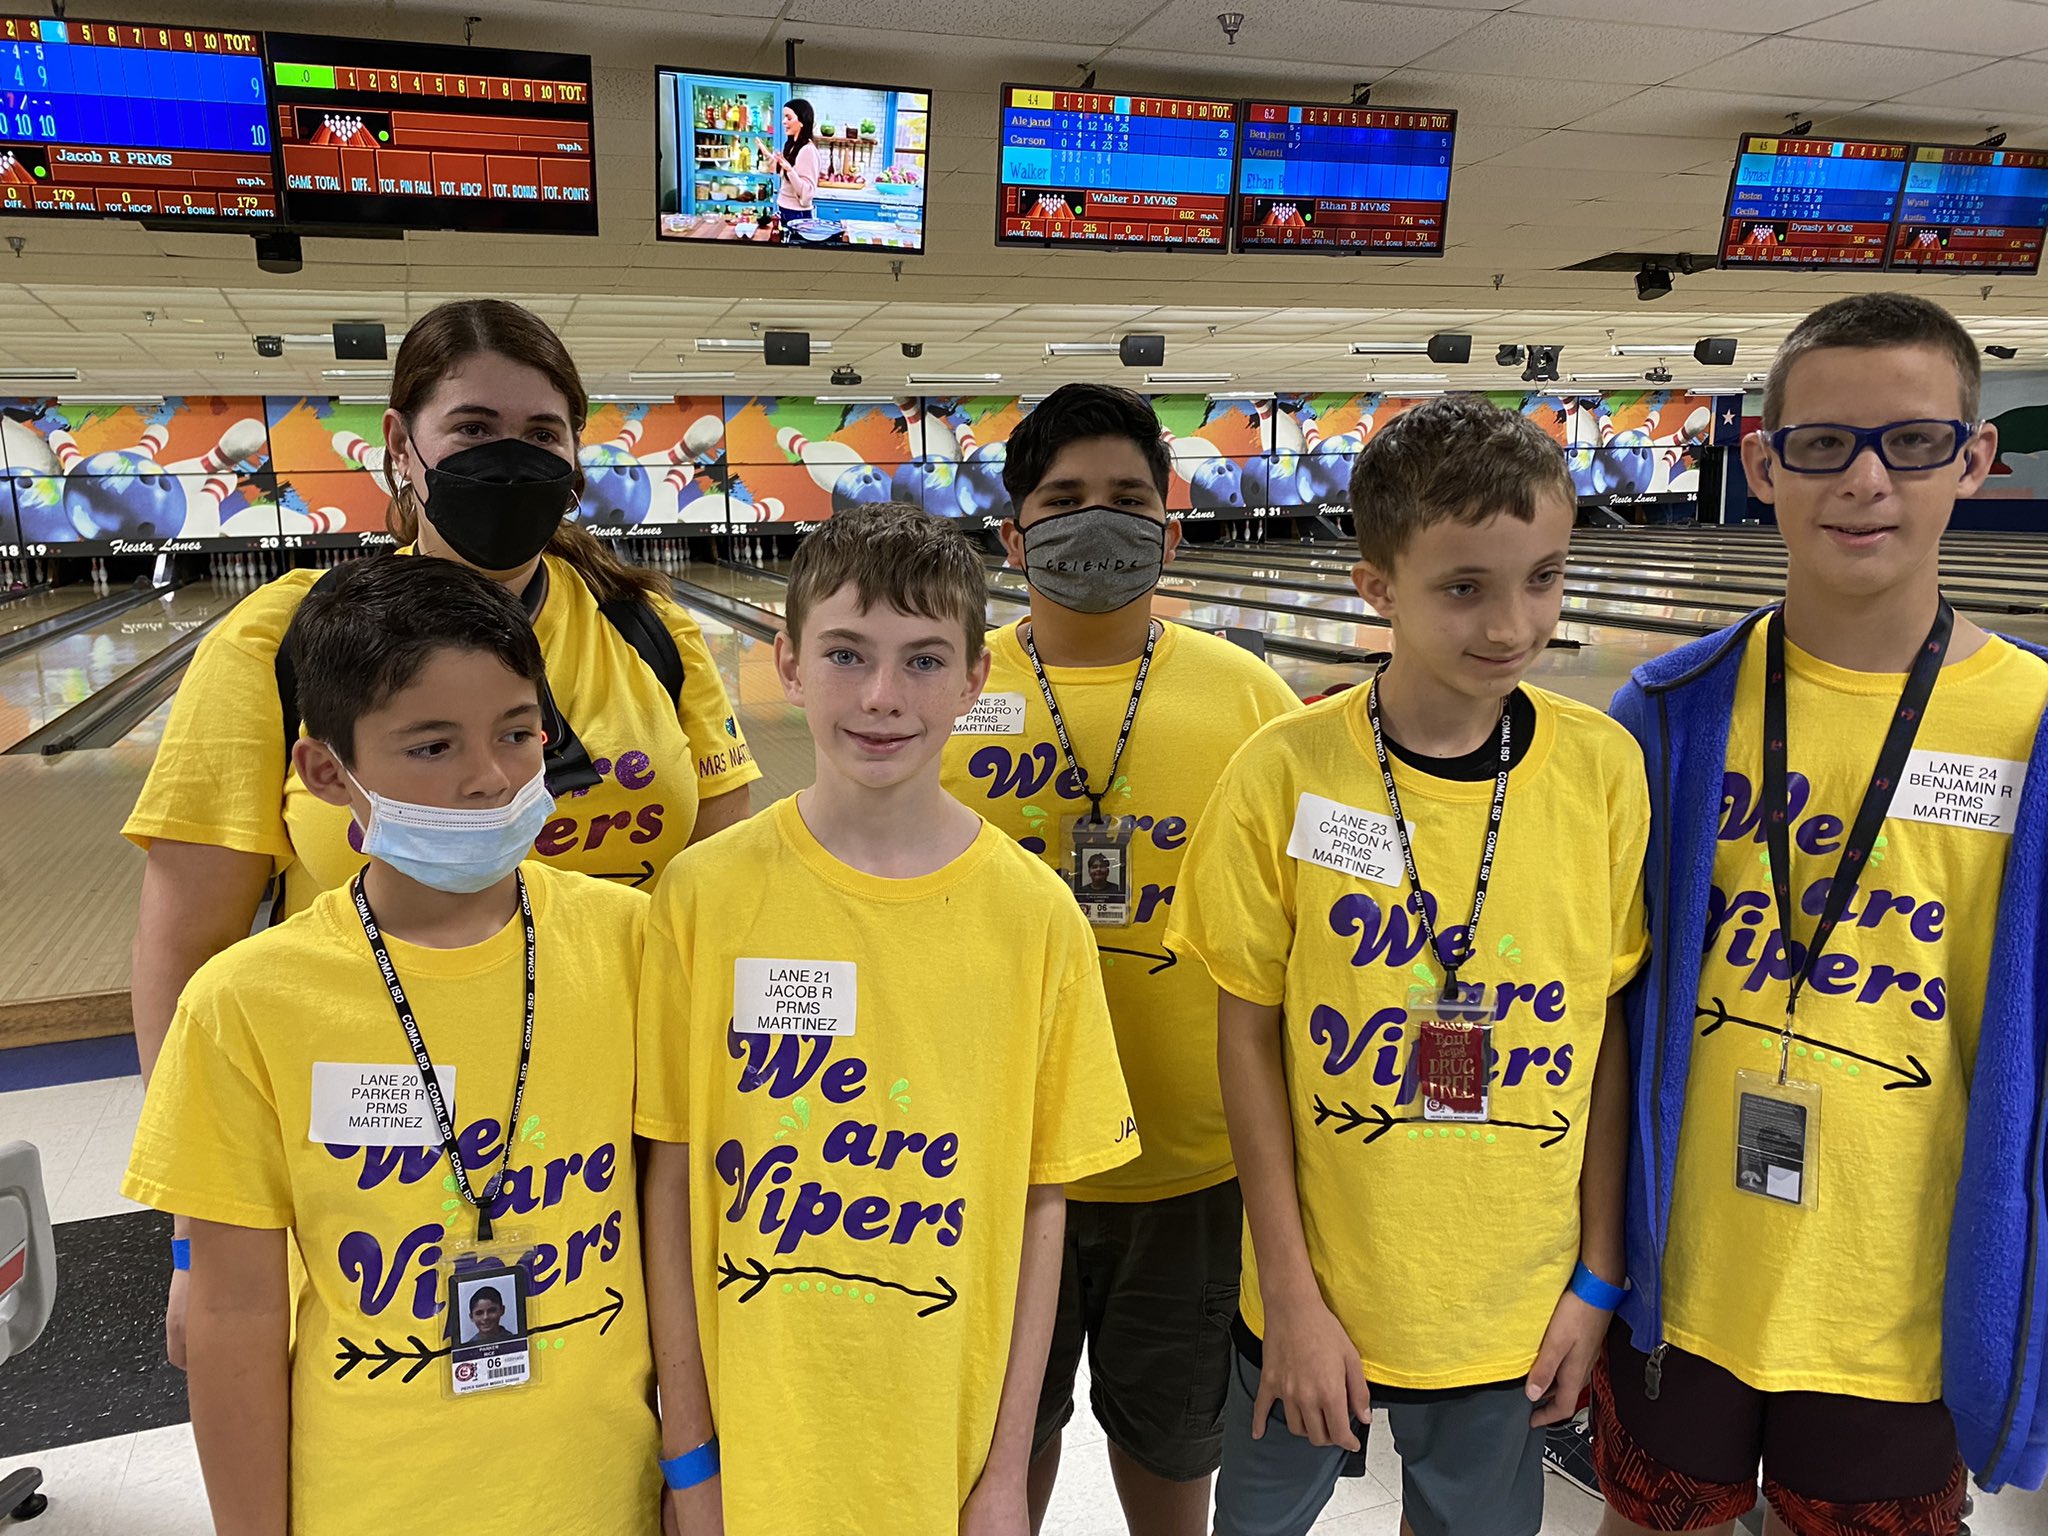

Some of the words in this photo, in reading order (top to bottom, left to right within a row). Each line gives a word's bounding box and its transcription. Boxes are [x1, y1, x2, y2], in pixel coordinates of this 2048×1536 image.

[204, 34, 216, 49] 10
[224, 34, 255, 51] TOT.
[541, 85, 552, 100] 10
[559, 85, 585, 101] TOT.
[251, 125, 266, 146] 10
[1010, 135, 1046, 146] Carson
[57, 149, 103, 163] Jacob
[109, 152, 121, 164] R
[127, 153, 173, 166] PRMS
[1010, 163, 1049, 180] Walker
[288, 175, 312, 189] GAME
[315, 176, 340, 191] TOTAL
[351, 177, 371, 191] DIFF.
[380, 179, 398, 193] TOT.
[400, 180, 413, 193] PIN
[415, 181, 432, 195] FALL
[440, 181, 458, 195] TOT.
[461, 183, 482, 197] HDCP
[52, 189, 75, 202] 179
[492, 184, 510, 198] TOT.
[513, 185, 537, 199] BONUS
[544, 186, 561, 200] TOT.
[563, 187, 589, 201] POINTS
[1091, 193, 1129, 204] Walker
[1144, 196, 1178, 206] MVMS
[36, 201, 57, 210] TOT.
[59, 202, 74, 211] PIN
[76, 202, 95, 211] FALL
[105, 203, 123, 212] TOT.
[165, 206, 185, 214] TOT.
[188, 207, 215, 215] BONUS
[237, 197, 258, 209] 179
[1320, 201, 1347, 211] Ethan
[1360, 203, 1391, 212] MVMS
[222, 208, 243, 217] TOT.
[245, 208, 274, 218] POINTS
[1687, 493, 1697, 501] 36
[1187, 508, 1215, 519] Lanes
[1253, 508, 1265, 517] 30
[1268, 507, 1281, 516] 31
[1318, 503, 1345, 515] Fiesta
[586, 524, 623, 537] Fiesta
[626, 523, 663, 536] Lanes
[710, 524, 727, 534] 24
[731, 524, 748, 535] 25
[26, 544, 46, 556] 19
[110, 539, 155, 555] Fiesta
[157, 538, 202, 554] Lanes
[260, 537, 279, 549] 20
[284, 536, 302, 548] 21
[699, 753, 726, 778] MRS
[968, 742, 1089, 799] We
[1929, 761, 1974, 778] LANE
[1979, 767, 1998, 780] 24
[1494, 771, 1507, 804] COMAL
[1910, 773, 1996, 795] BENJAMIN
[2001, 786, 2013, 798] R
[1935, 792, 1984, 809] PRMS
[1331, 810, 1368, 831] LANE
[1370, 822, 1387, 836] 23
[1913, 804, 2001, 828] MARTINEZ
[534, 804, 664, 857] ers
[1319, 821, 1377, 848] CARSON
[1382, 839, 1393, 852] K
[1331, 839, 1373, 861] PRMS
[1483, 831, 1497, 863] COMAL
[1312, 848, 1385, 879] MARTINEZ
[356, 893, 371, 925] COMAL
[1801, 877, 1946, 943] are
[1329, 890, 1476, 968] We
[375, 949, 391, 985] COMAL
[769, 969, 809, 984] LANE
[814, 971, 830, 984] 21
[765, 984, 818, 999] JACOB
[822, 986, 833, 999] R
[775, 1001, 820, 1015] PRMS
[757, 1016, 838, 1031] MARTINEZ
[402, 1014, 422, 1052] COMAL
[728, 1016, 868, 1104] We
[1429, 1058, 1475, 1075] DRUG
[361, 1074, 398, 1086] LANE
[402, 1075, 418, 1086] 20
[1429, 1075, 1475, 1099] FREE
[352, 1088, 410, 1100] PARKER
[416, 1089, 425, 1100] R
[427, 1082, 446, 1122] COMAL
[366, 1103, 407, 1114] PRMS
[348, 1117, 423, 1129] MARTINEZ
[822, 1120, 959, 1179] are
[481, 1142, 616, 1219] are
[716, 1139, 966, 1255] Vipers
[338, 1210, 622, 1340] Viers
[487, 1358, 501, 1368] 06
